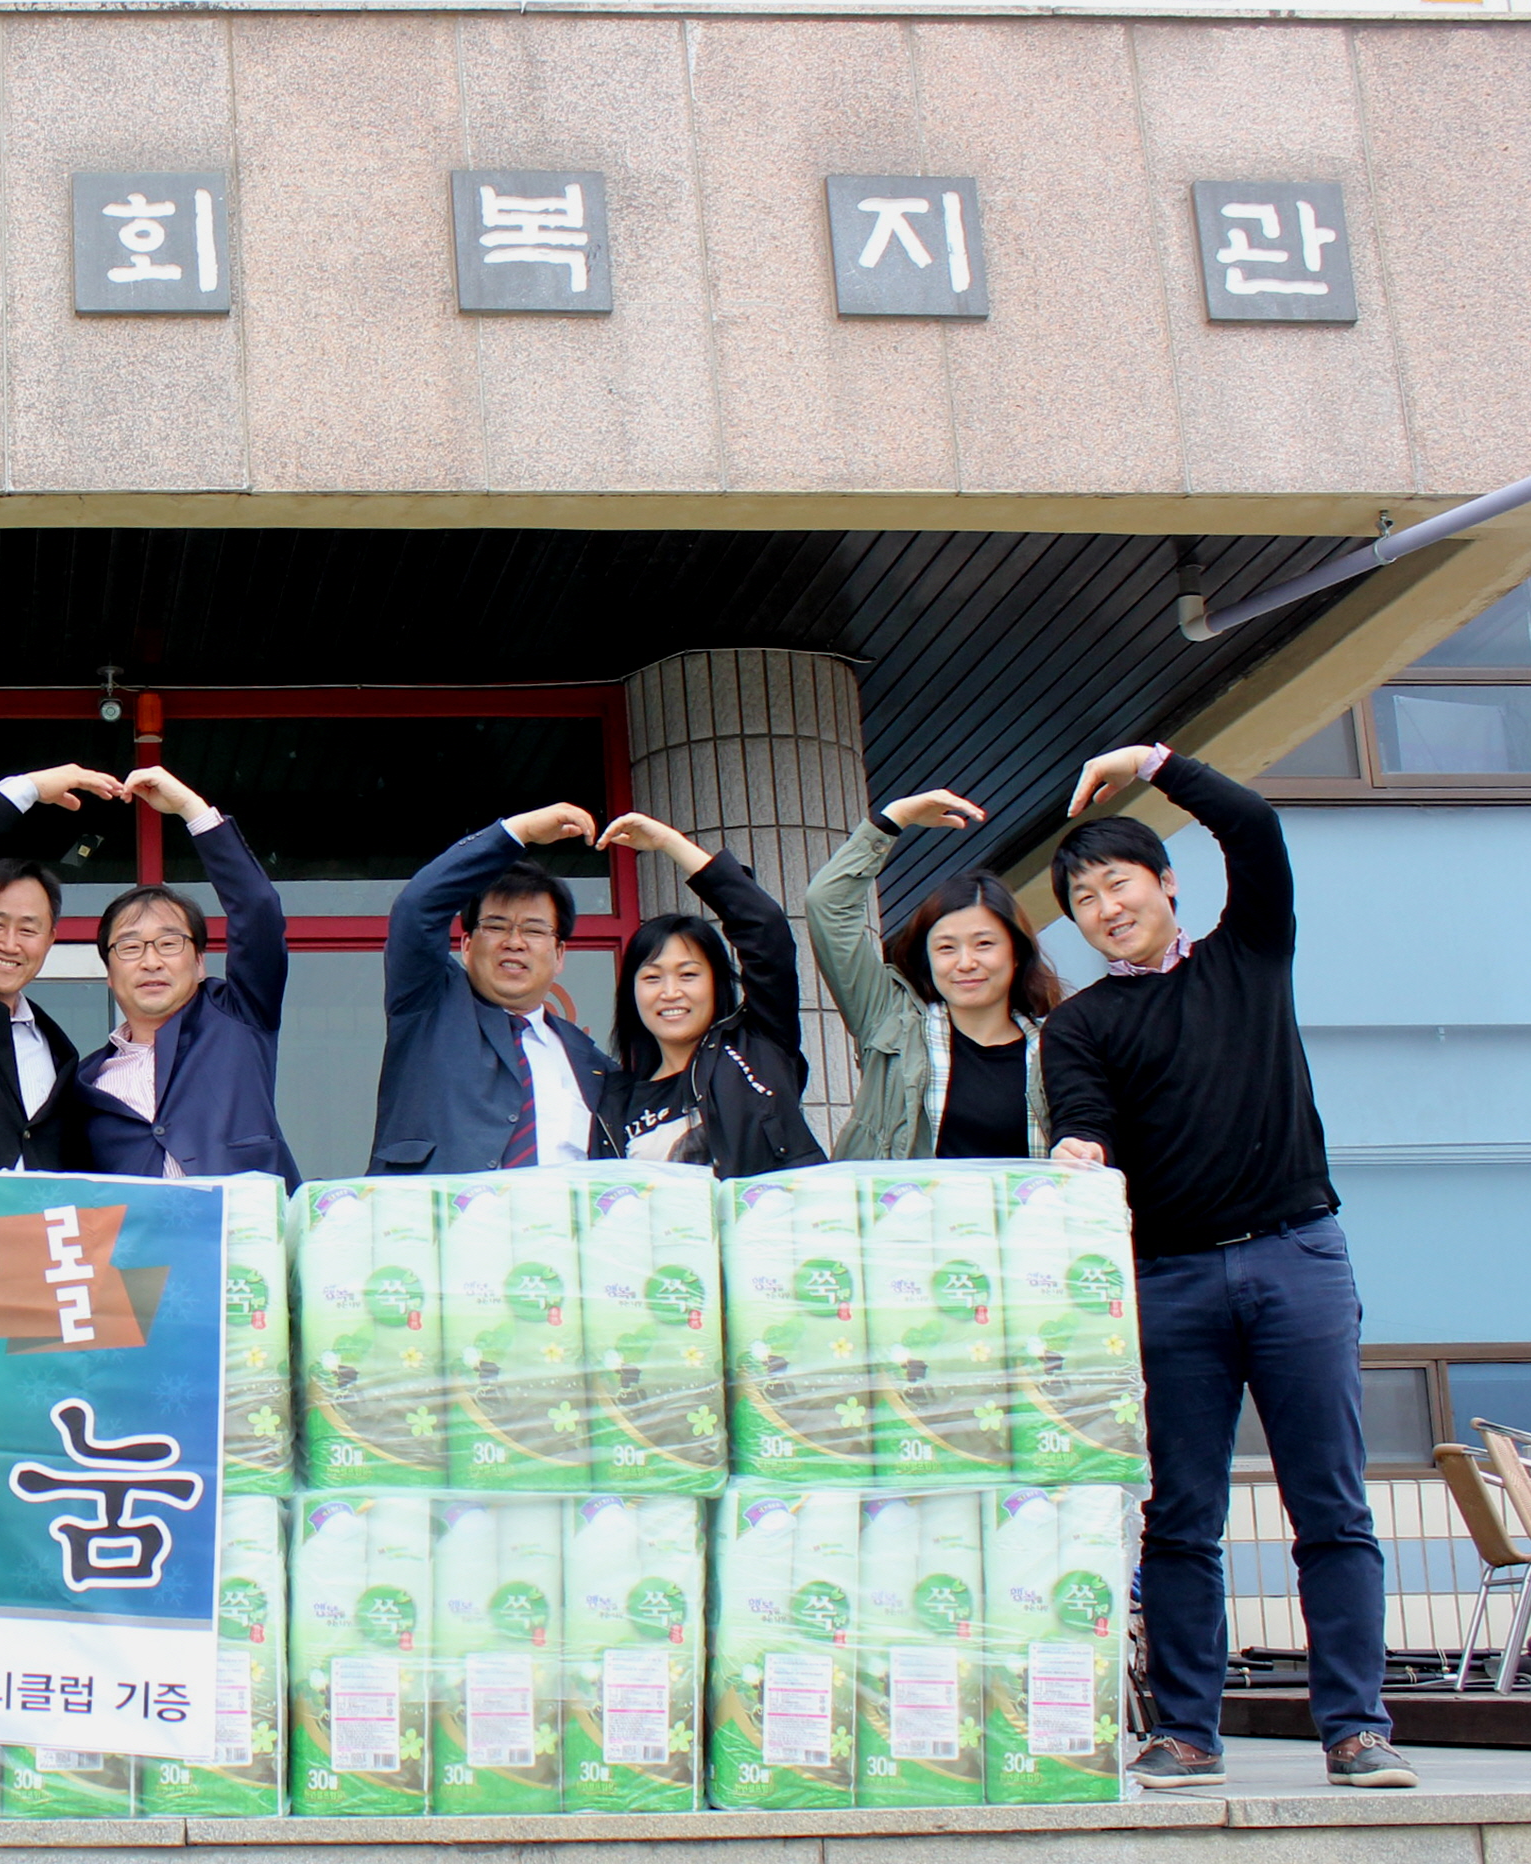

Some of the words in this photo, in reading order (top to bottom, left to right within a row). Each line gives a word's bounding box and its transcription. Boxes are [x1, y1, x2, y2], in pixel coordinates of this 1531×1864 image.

[43, 1205, 95, 1344] 롤
[805, 1271, 839, 1303] 쑥
[943, 1273, 977, 1307] 쑥
[1078, 1268, 1111, 1301] 쑥
[375, 1279, 409, 1313] 쑥
[518, 1275, 551, 1309] 쑥
[658, 1280, 692, 1313] 쑥
[367, 1598, 402, 1632] 쑥
[639, 1591, 674, 1625] 쑥
[803, 1596, 837, 1631] 쑥
[925, 1587, 960, 1621] 쑥
[1064, 1584, 1097, 1619] 쑥
[115, 1680, 191, 1722] 기증
